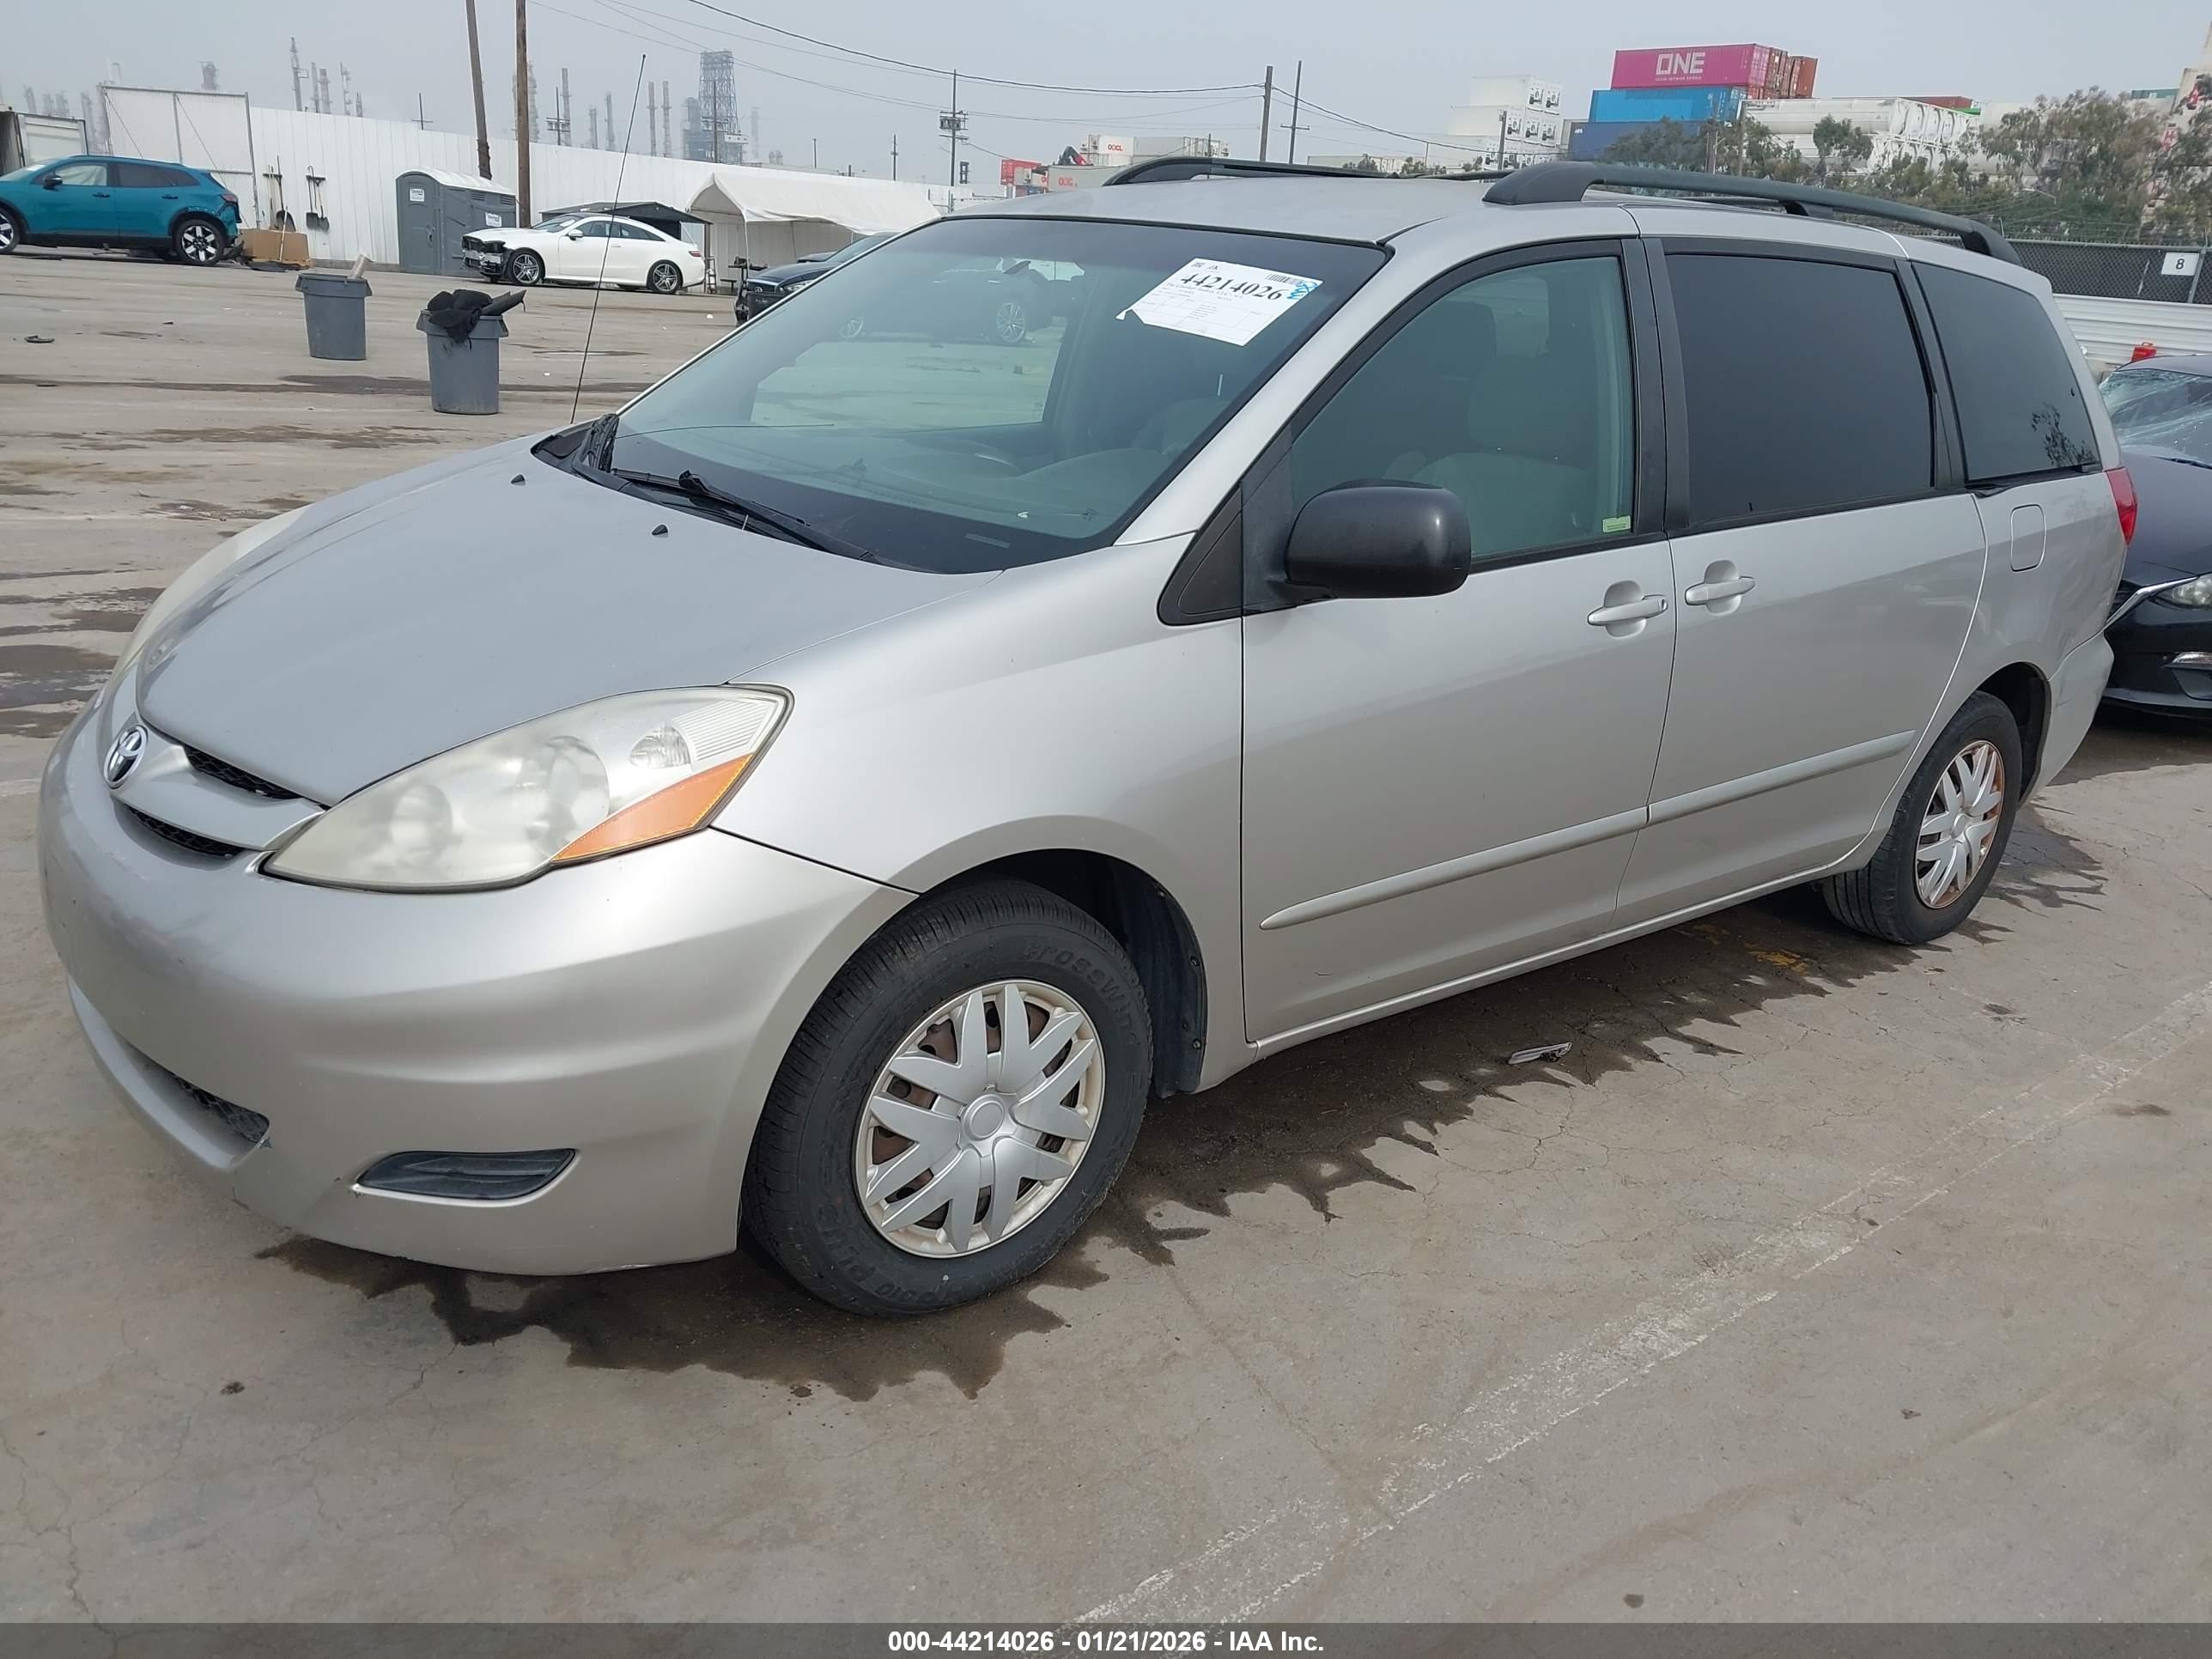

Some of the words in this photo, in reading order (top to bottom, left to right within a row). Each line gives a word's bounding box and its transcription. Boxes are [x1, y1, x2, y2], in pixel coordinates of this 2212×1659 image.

[1655, 52, 1706, 76] ONE
[1107, 143, 1123, 152] OOCL
[1059, 177, 1077, 186] OOC
[2176, 258, 2185, 270] 8
[1180, 272, 1288, 301] 44214026
